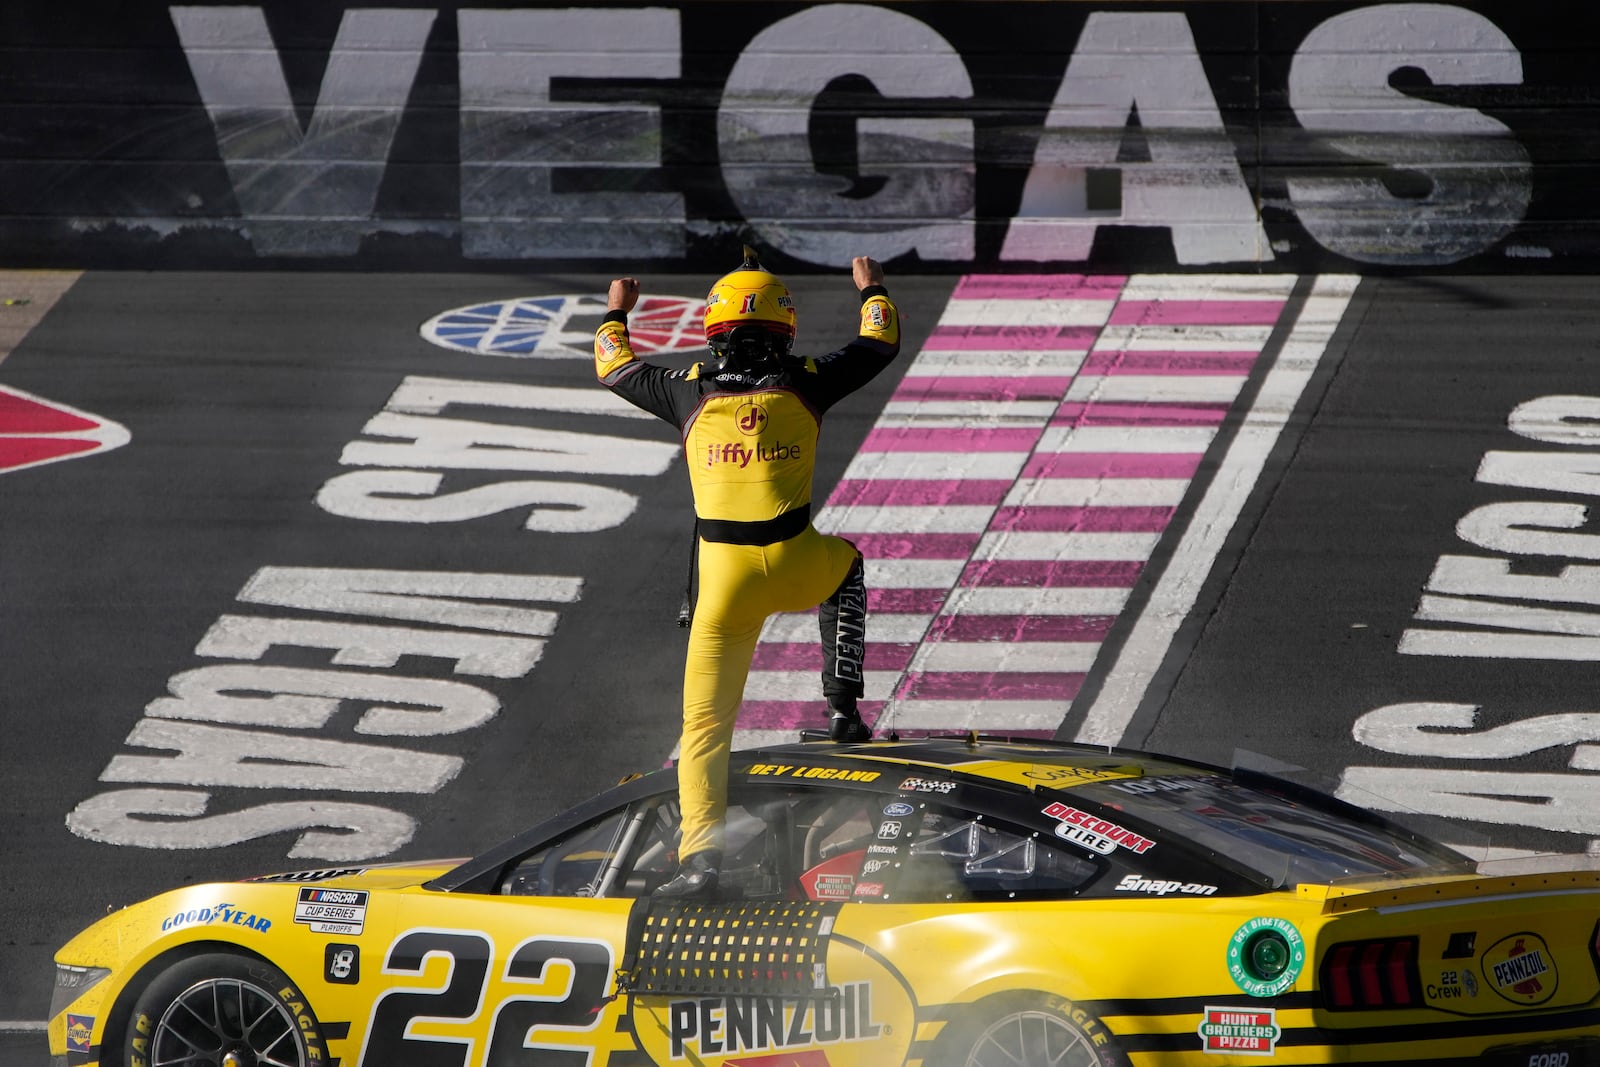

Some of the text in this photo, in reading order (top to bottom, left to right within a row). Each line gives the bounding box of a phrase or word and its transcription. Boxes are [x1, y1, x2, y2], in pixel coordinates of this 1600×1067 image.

[169, 3, 1532, 266] VEGAS
[707, 441, 800, 469] jiffy lube
[66, 375, 683, 861] LAS VEGAS
[792, 766, 882, 782] LOGANO
[886, 803, 909, 815] Ford
[1041, 801, 1157, 854] DISCOUNT
[1063, 825, 1112, 850] TIRE
[867, 844, 898, 854] Mazak
[1115, 874, 1218, 895] Snap-on
[320, 890, 358, 904] NASCAR
[305, 906, 356, 919] CUP SERIES
[320, 923, 352, 933] PLAYOFFS
[1234, 917, 1301, 948] GET BIOETHANOL
[1231, 965, 1245, 982] GET
[1442, 971, 1458, 984] 22
[1493, 950, 1548, 988] PENNZOIL
[357, 927, 614, 1067] 22
[1427, 984, 1461, 1000] Crew
[278, 986, 321, 1061] EAGLE
[669, 980, 882, 1060] PENNZOIL
[1045, 996, 1108, 1047] EAGLE
[1220, 1013, 1258, 1025] HUNT
[1205, 1025, 1273, 1037] BROTHERS
[1219, 1036, 1259, 1048] PIZZA
[1529, 1053, 1569, 1067] FORD
